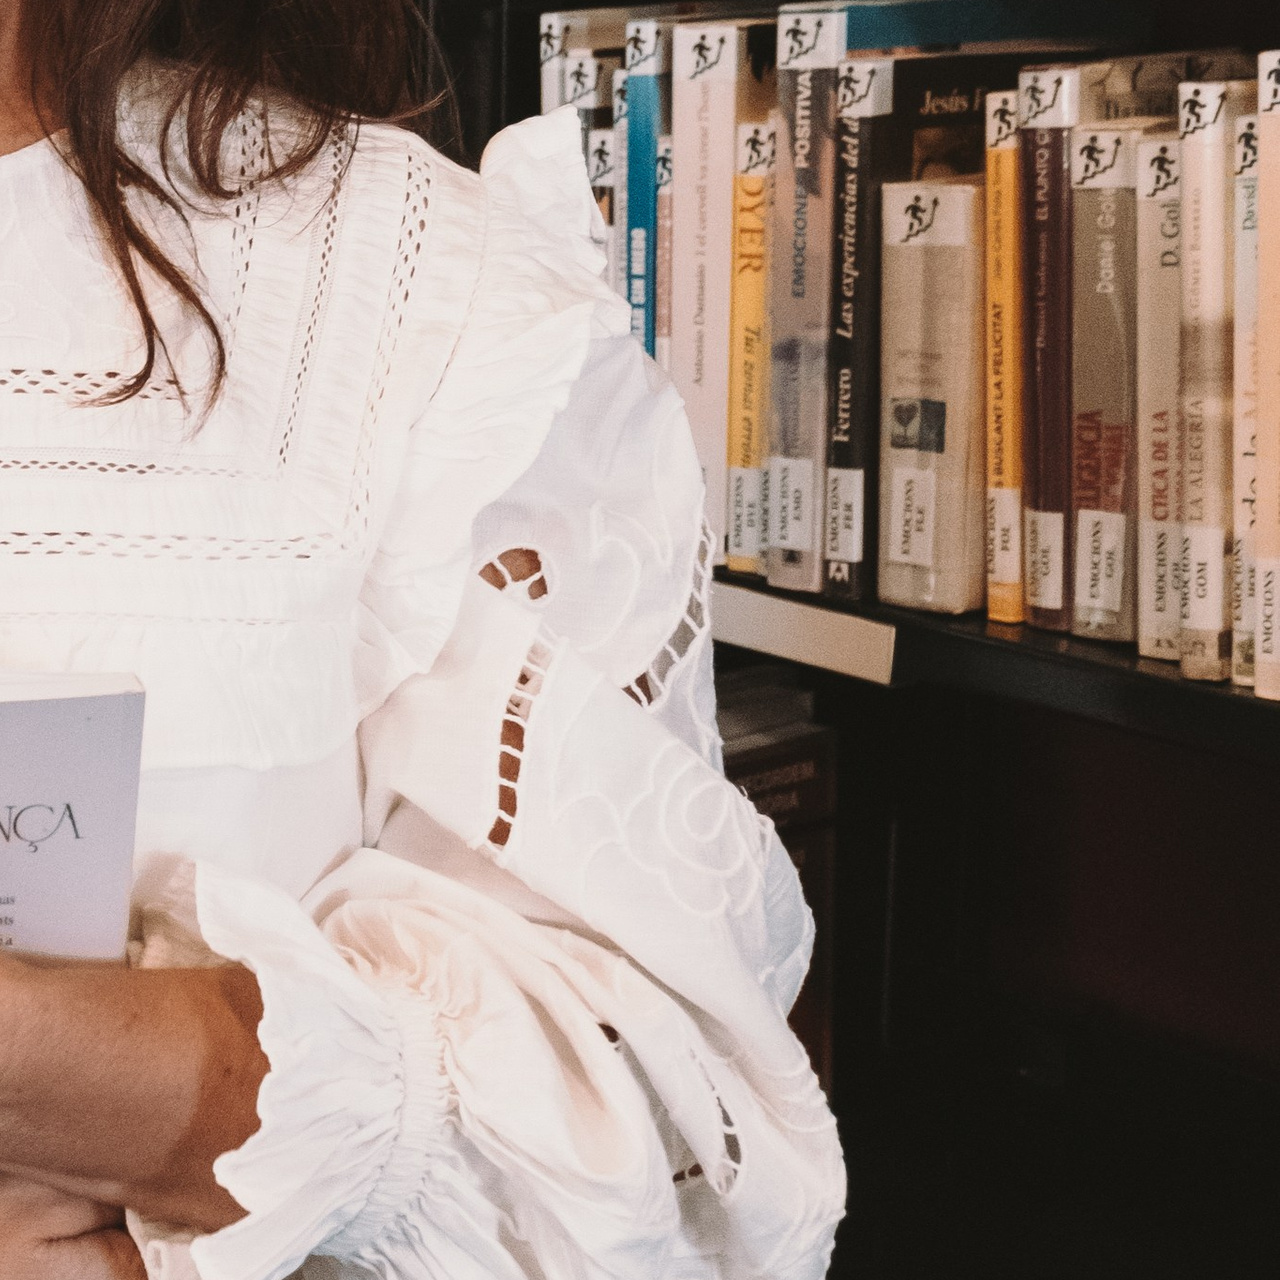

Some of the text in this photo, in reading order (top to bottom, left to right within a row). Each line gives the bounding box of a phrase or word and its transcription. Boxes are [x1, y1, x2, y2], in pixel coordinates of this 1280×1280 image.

[920, 88, 969, 116] Jesús
[832, 135, 862, 443] Ferrero Las experiencias del
[1095, 233, 1116, 294] Daniel
[1160, 249, 1181, 269] D.
[693, 263, 706, 325] Damasio
[692, 328, 705, 387] Antonio
[743, 324, 762, 354] Tus
[991, 300, 1004, 479] BUSCANT LA FELICITAT
[1089, 520, 1102, 600] EMOCIONS
[1155, 532, 1169, 613] EMOCIONS
[1262, 570, 1276, 654] EMOCIONS
